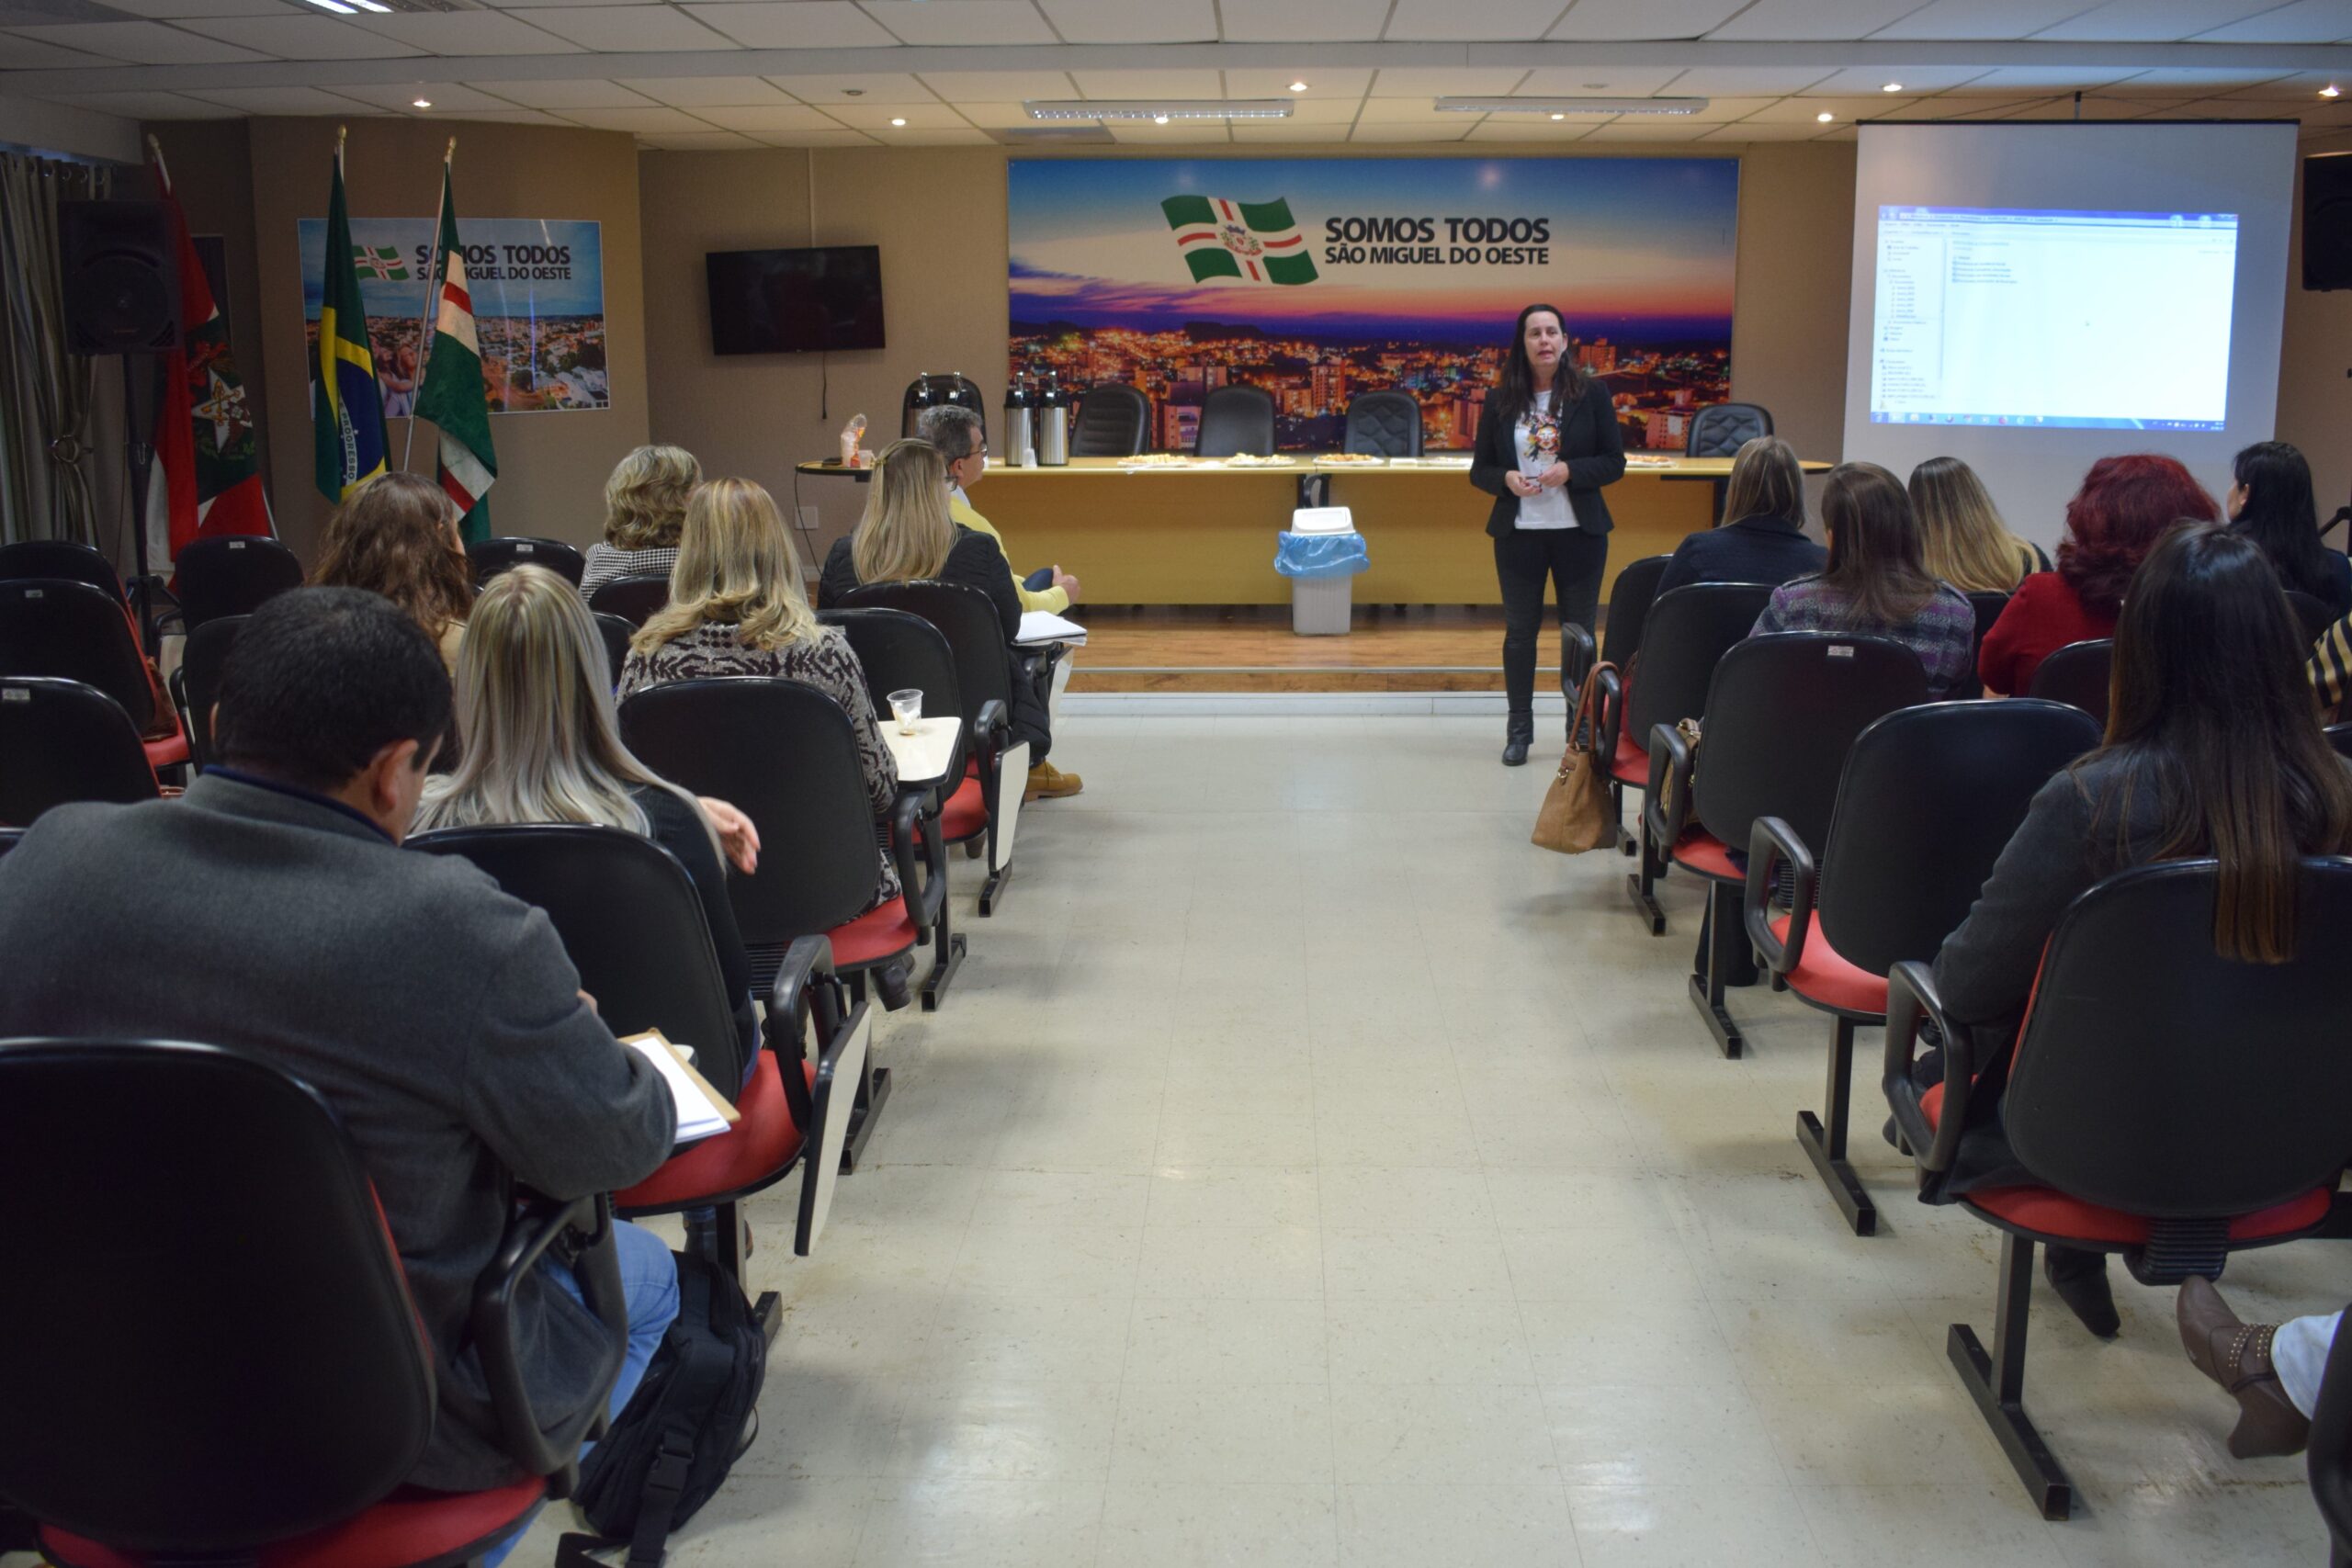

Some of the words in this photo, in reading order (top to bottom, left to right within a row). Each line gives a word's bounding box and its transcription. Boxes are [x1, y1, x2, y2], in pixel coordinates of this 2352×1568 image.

[1325, 217, 1435, 243] SOMOS
[1444, 217, 1550, 243] TODOS
[503, 245, 571, 265] TODOS
[1325, 243, 1366, 265] SÃO
[1370, 246, 1445, 265] MIGUEL
[1449, 246, 1481, 265] DO
[1486, 246, 1549, 265] OESTE
[508, 266, 529, 280] DO
[532, 266, 571, 280] OESTE
[341, 412, 356, 479] PROGRESSO
